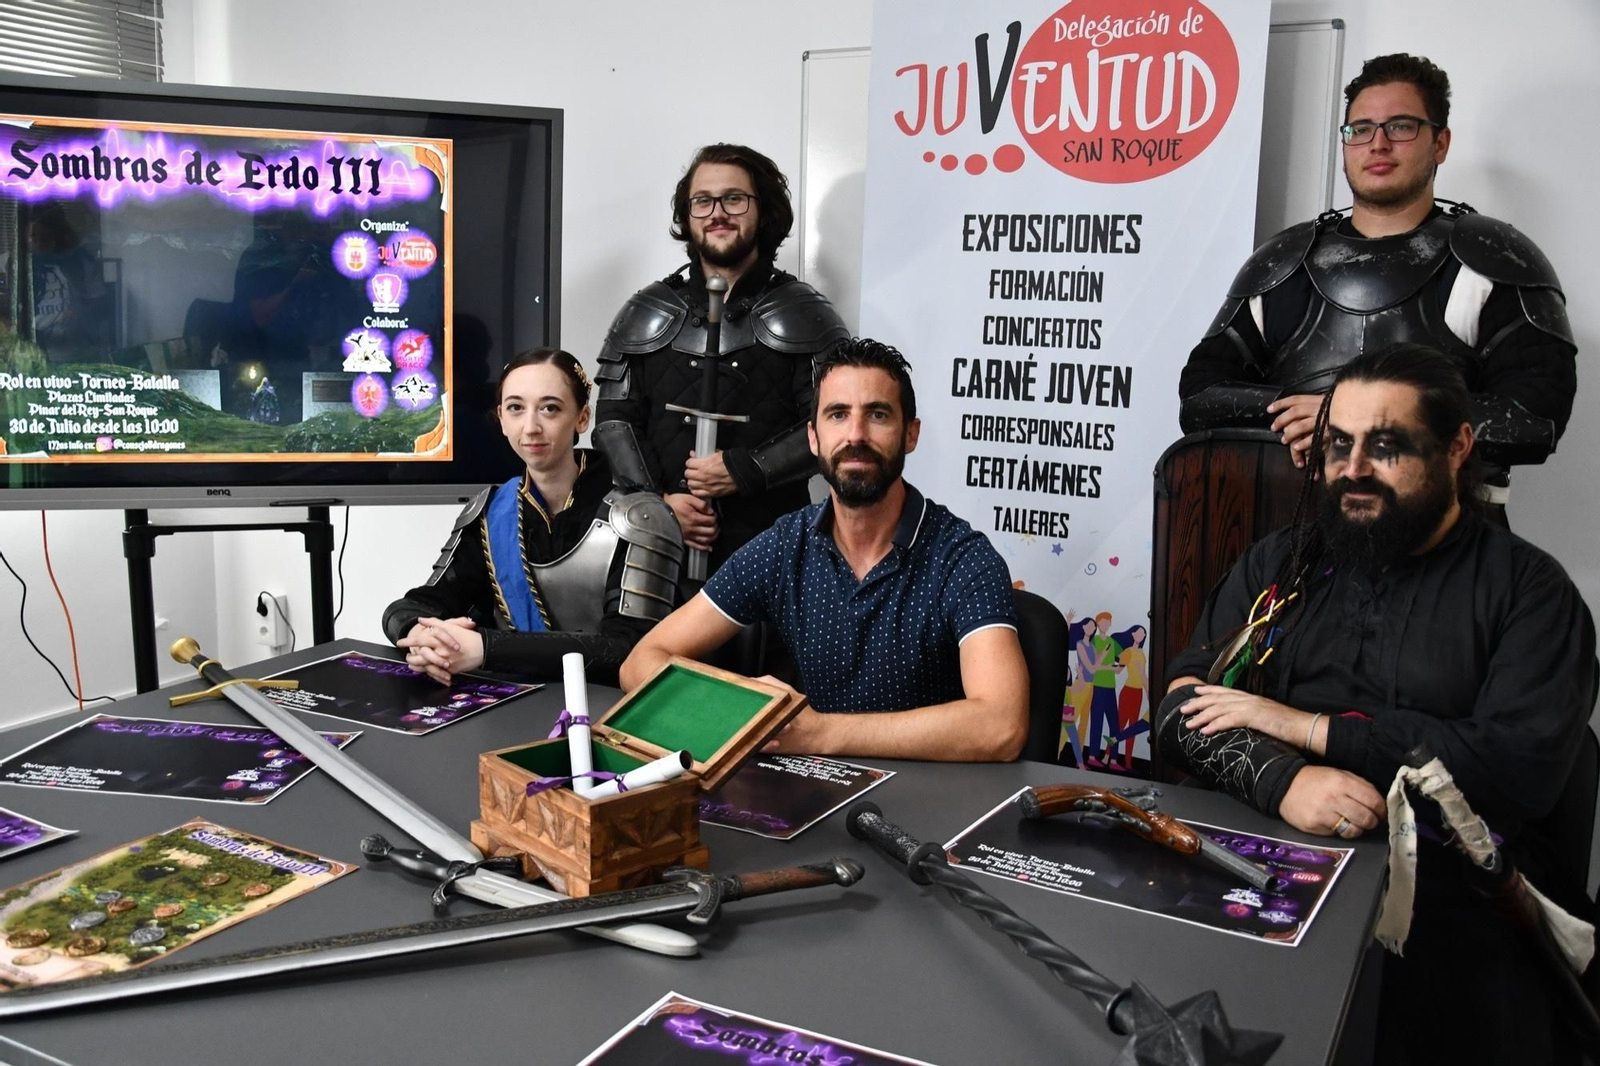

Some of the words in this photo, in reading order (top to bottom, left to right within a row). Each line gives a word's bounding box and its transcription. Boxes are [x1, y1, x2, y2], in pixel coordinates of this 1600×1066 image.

[1054, 11, 1170, 47] Delegación
[1179, 8, 1204, 37] de
[894, 20, 1217, 136] JUVENTUD
[8, 140, 168, 184] Sombras
[185, 150, 223, 186] de
[236, 150, 319, 191] Erdo
[326, 155, 384, 196] III
[1063, 137, 1103, 163] SAN
[1112, 138, 1183, 166] ROQUE
[360, 218, 410, 234] Organiza:
[962, 214, 1142, 254] EXPOSICIONES
[989, 265, 1104, 302] FORMACIÓN
[363, 316, 409, 329] Colabora:
[983, 315, 1102, 349] CONCIERTOS
[0, 372, 24, 391] Rol
[25, 376, 41, 389] en
[46, 389, 84, 403] Plazas
[84, 389, 136, 404] Limitadas
[951, 353, 1038, 402] CARNÉ
[1044, 362, 1133, 408] JOVEN
[9, 418, 28, 434] 30
[29, 418, 46, 434] de
[46, 417, 82, 435] Julio
[82, 418, 121, 434] desde
[122, 418, 143, 434] las
[144, 418, 179, 434] 10:00
[27, 402, 60, 416] Pinar
[61, 403, 77, 416] del
[125, 403, 159, 418] Roque
[961, 413, 1115, 451] CORRESPONSALES
[966, 454, 1102, 498] CERTÁMENES
[993, 505, 1069, 539] TALLERES
[191, 830, 249, 854] Sombras
[245, 848, 264, 858] de
[264, 850, 298, 869] Erdo
[977, 843, 995, 852] Rol
